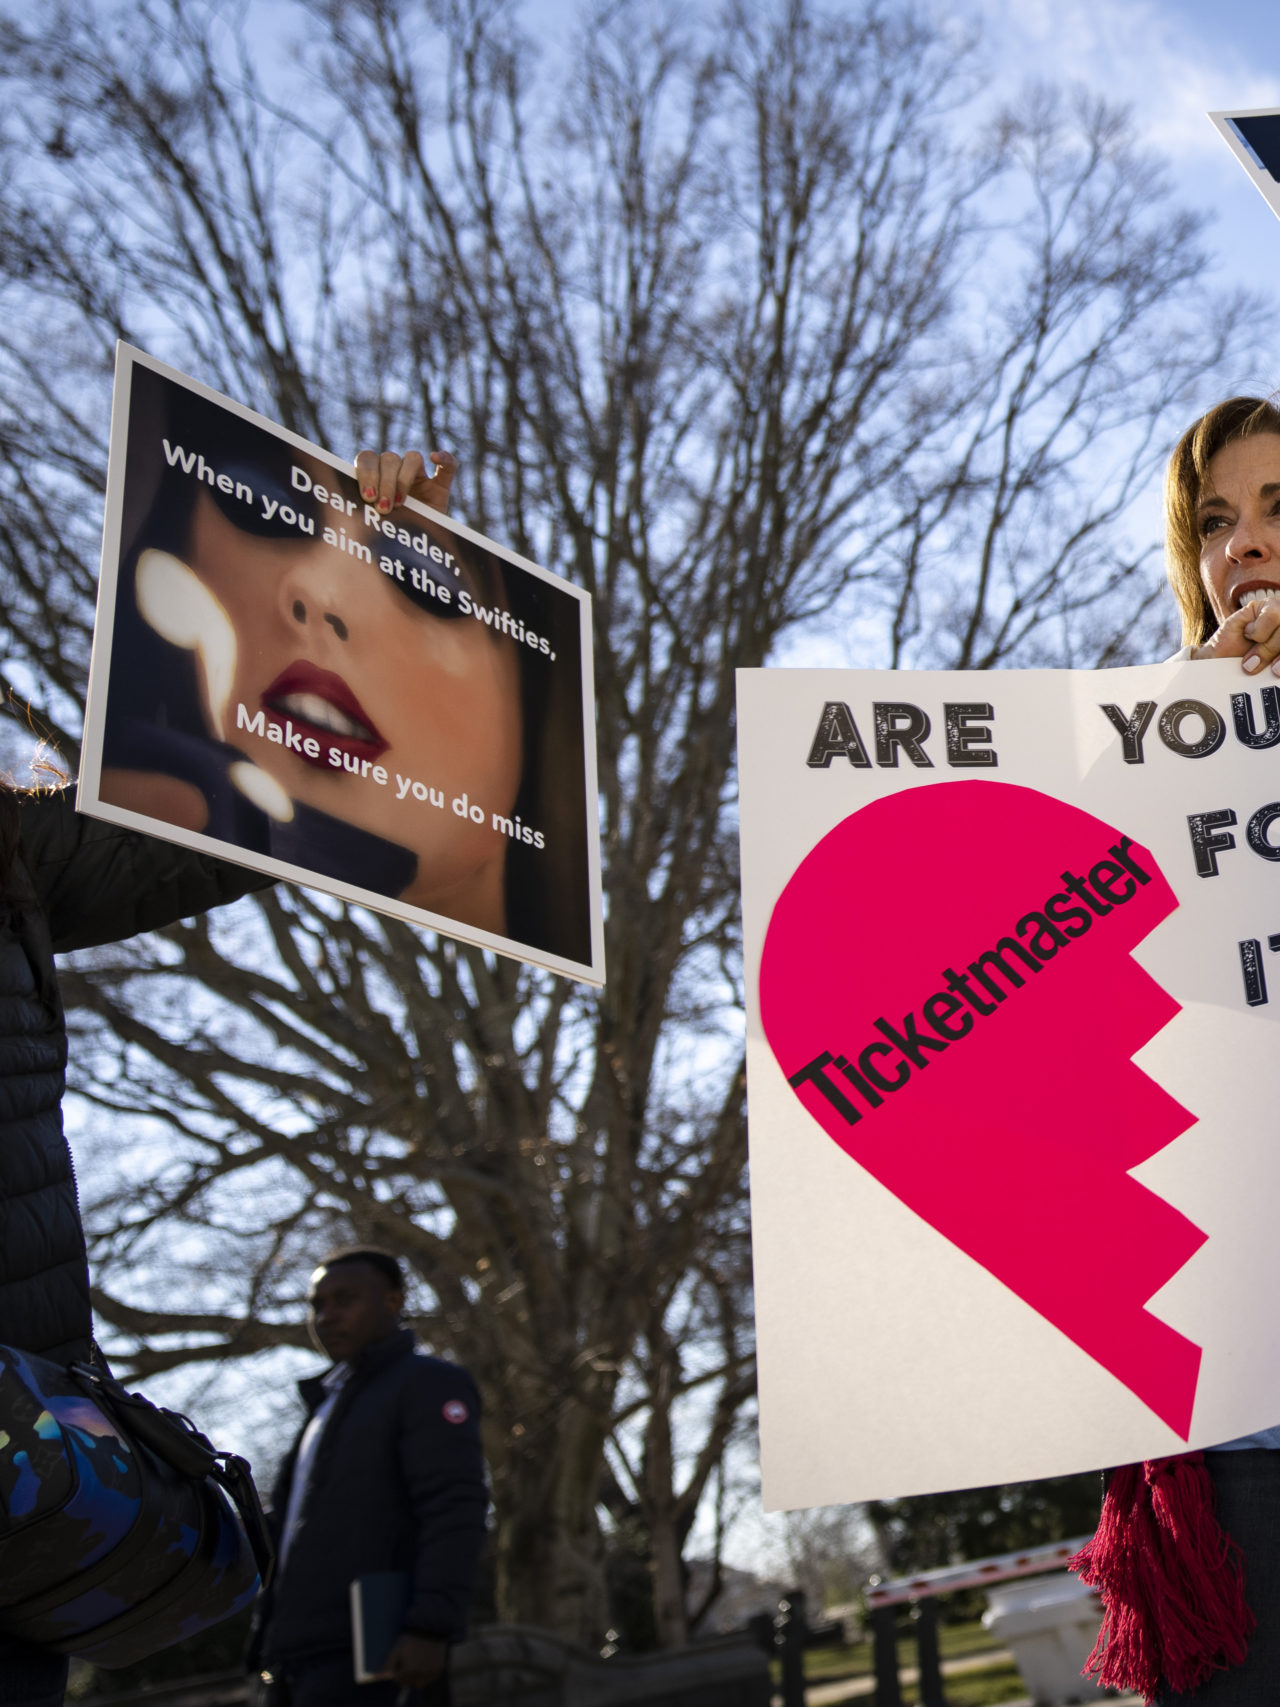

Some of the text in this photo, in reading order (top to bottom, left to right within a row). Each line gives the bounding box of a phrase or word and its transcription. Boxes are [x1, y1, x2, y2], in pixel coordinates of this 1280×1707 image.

[162, 439, 557, 662] When you aim at the Swifties,
[290, 465, 460, 576] Dear Reader,
[236, 703, 546, 849] Make sure you do miss
[806, 701, 998, 768] ARE
[788, 836, 1153, 1126] Ticketmaster
